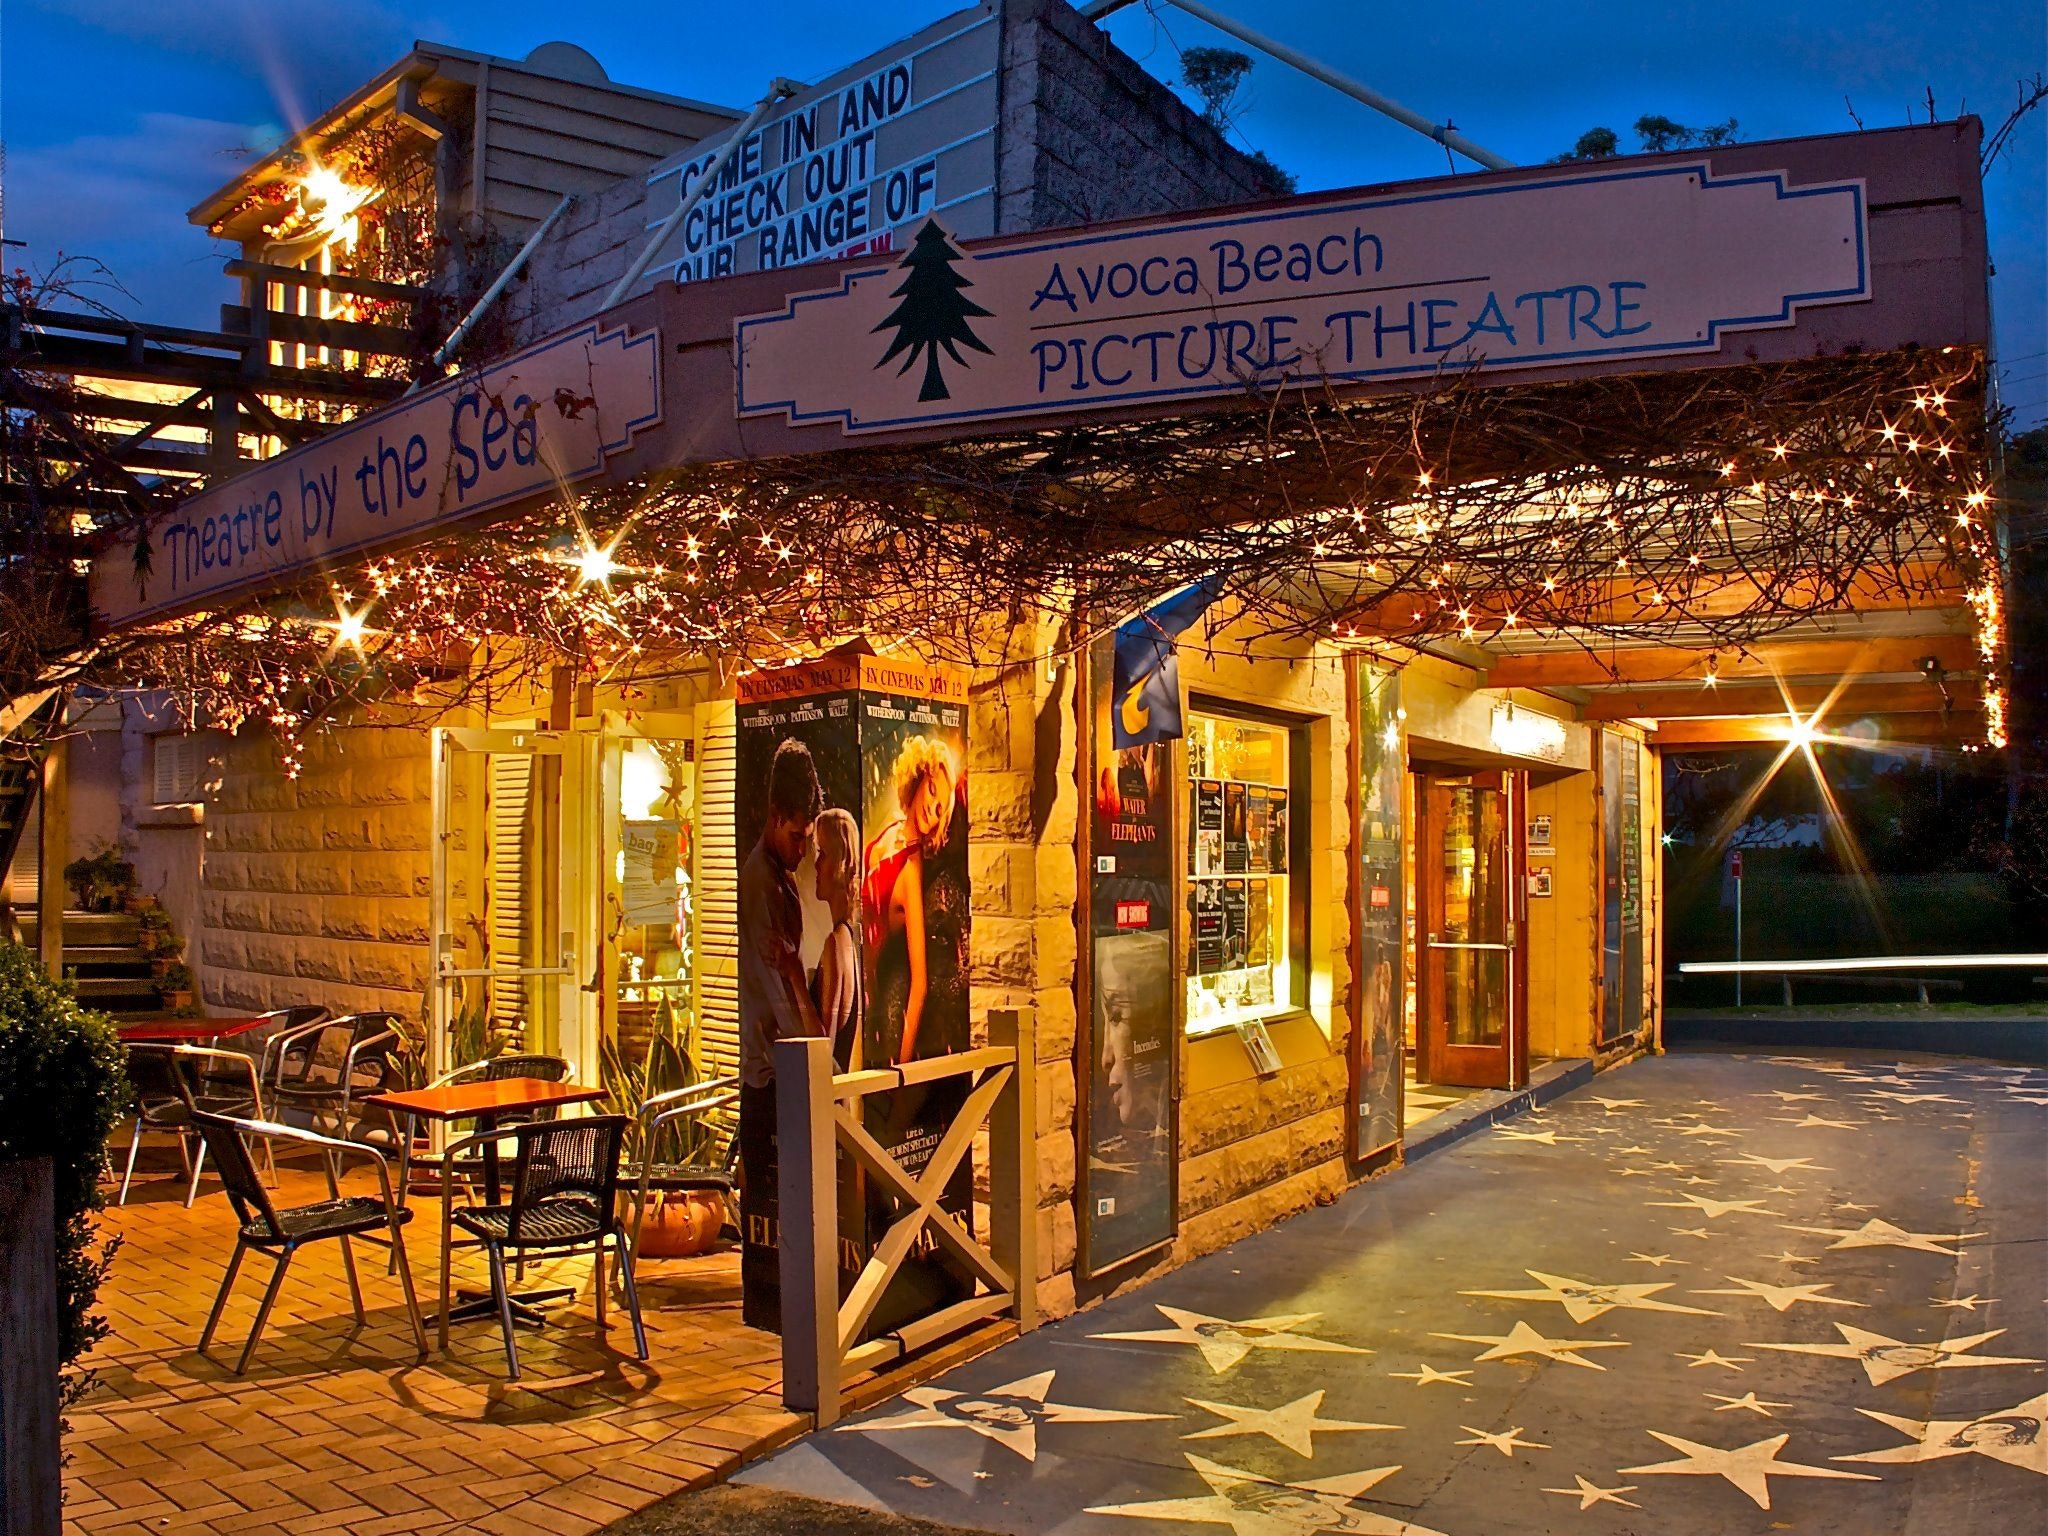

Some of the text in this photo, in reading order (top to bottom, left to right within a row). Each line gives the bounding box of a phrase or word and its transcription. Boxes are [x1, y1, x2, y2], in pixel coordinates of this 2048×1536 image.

[783, 107, 816, 164] IN
[840, 65, 910, 138] AND
[676, 247, 732, 282] OUR
[759, 188, 868, 270] RANGE
[886, 160, 935, 222] OF
[685, 131, 874, 253] CHECK OUT
[1030, 226, 1383, 313] Avoca Beach
[1030, 281, 1652, 392] PICTURE THEATRE
[163, 392, 538, 591] Theatre by the Sea
[839, 666, 851, 684] 12
[866, 667, 962, 697] IN CINEMAS MAY 12
[866, 704, 906, 721] WITHERSPOON
[909, 710, 939, 725] PATTINSON
[1111, 822, 1156, 842] ELEPHANTS
[1123, 797, 1147, 815] WATER
[628, 832, 655, 855] bag
